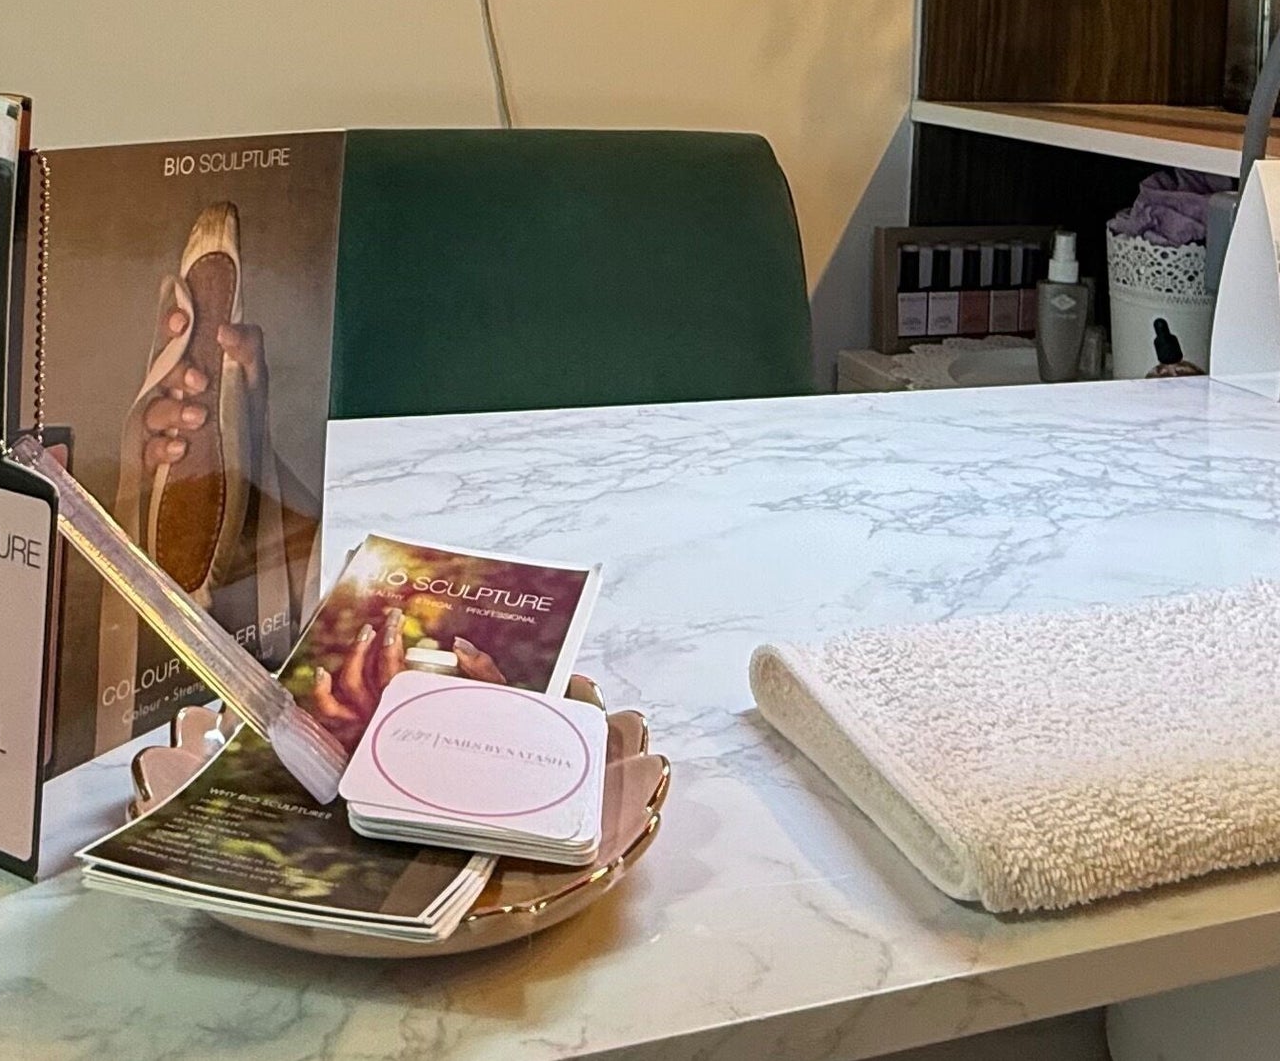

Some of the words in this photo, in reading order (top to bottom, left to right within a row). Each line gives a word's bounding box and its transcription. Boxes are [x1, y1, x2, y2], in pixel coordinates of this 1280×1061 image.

[164, 155, 195, 176] BIO
[199, 147, 290, 173] SCULPTURE
[413, 576, 555, 612] SCULPTURE
[466, 607, 537, 625] PROFESSIONAL
[102, 658, 180, 707] COLOUR
[260, 613, 290, 636] GEL
[122, 698, 161, 724] Colour
[173, 681, 206, 702] Streng
[443, 736, 481, 751] NAILS
[484, 744, 502, 755] BY
[506, 748, 572, 769] NATASHA
[209, 787, 238, 798] WHY
[238, 793, 261, 803] BIO
